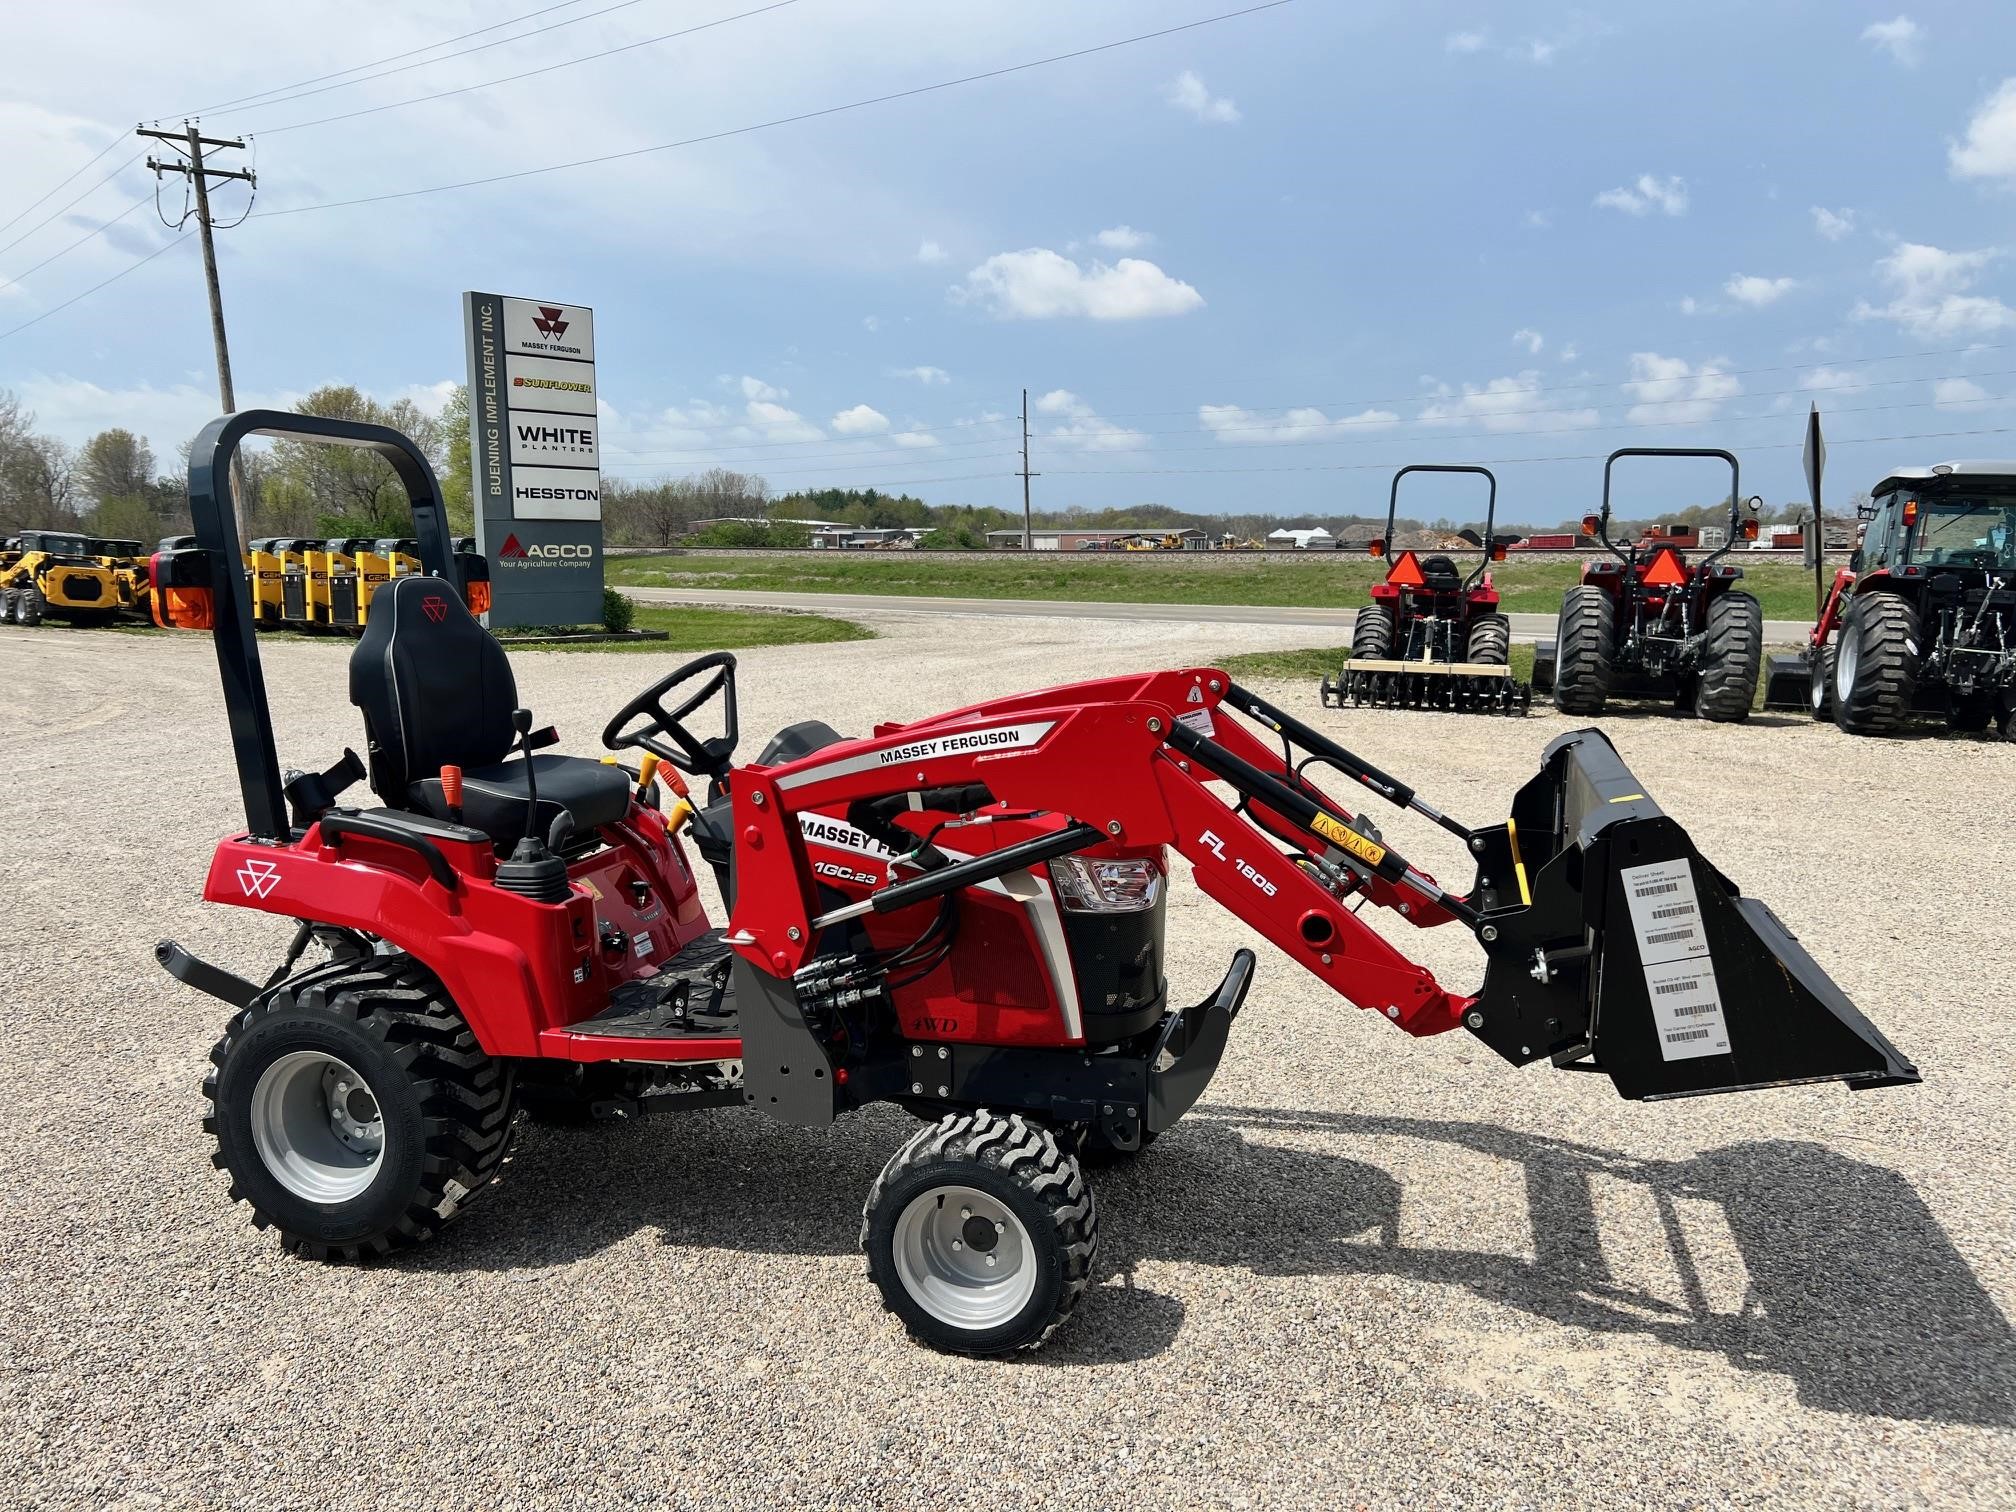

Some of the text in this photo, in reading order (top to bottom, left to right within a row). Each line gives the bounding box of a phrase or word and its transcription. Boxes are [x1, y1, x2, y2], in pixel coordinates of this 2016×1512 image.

[521, 341, 581, 354] MASSEY FERGUSON
[523, 378, 592, 393] SUNFLOWER
[481, 302, 501, 495] BUENING IMPLEMENT INC.
[517, 425, 593, 446] WHITE
[521, 444, 593, 453] PLANTERS
[516, 487, 599, 501] HESSTON
[528, 544, 592, 558] AGCO
[500, 560, 591, 569] Your Agriculture Company
[879, 730, 1020, 764] MASSEY FERGUSON
[800, 819, 872, 850] MASSEY
[1198, 829, 1278, 897] FL 1805
[814, 861, 878, 885] 1GC.23
